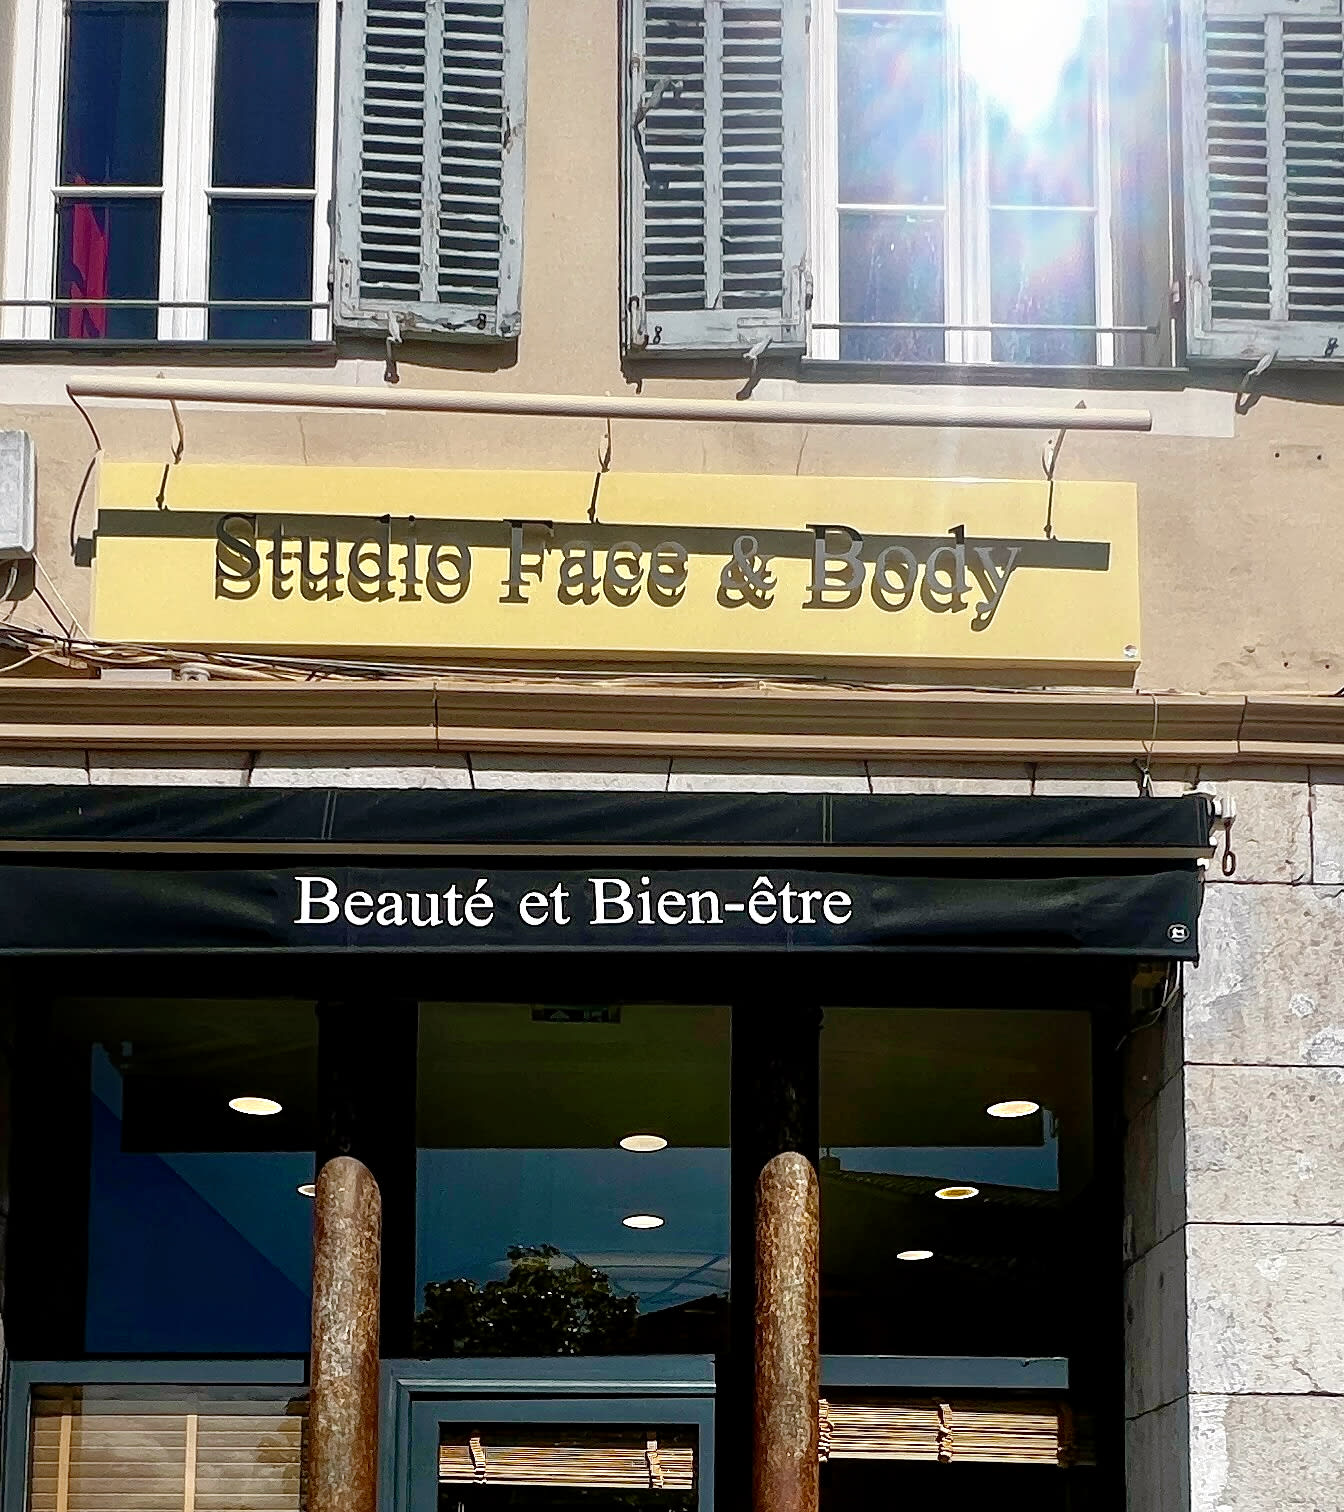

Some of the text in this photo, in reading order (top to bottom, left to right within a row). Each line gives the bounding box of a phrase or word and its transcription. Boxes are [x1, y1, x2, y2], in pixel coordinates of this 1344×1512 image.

[215, 512, 1023, 622] Studio Face & Body
[293, 875, 853, 927] Beauté et Bien-être
